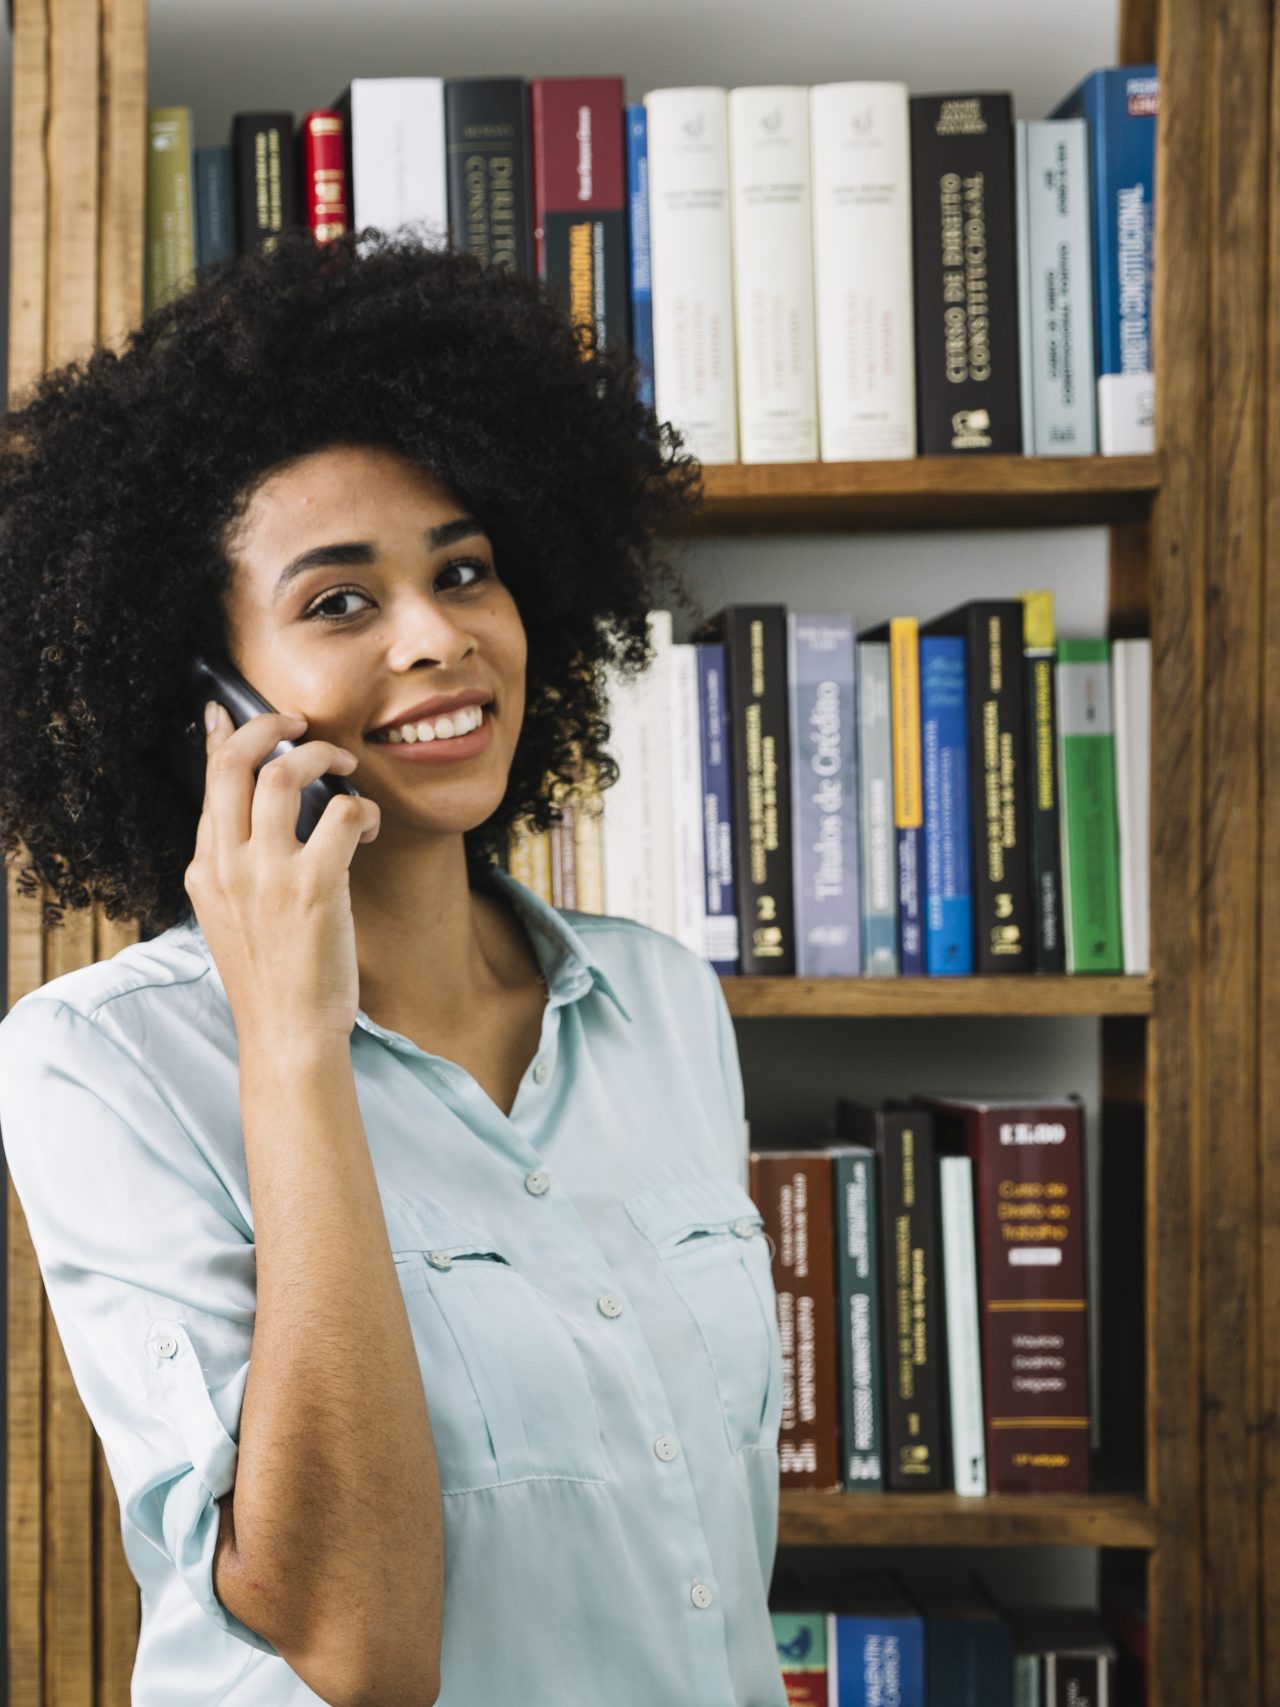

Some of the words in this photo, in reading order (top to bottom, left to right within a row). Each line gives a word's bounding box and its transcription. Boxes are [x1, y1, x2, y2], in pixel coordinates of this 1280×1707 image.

[939, 172, 963, 266] DIREITO
[942, 269, 964, 303] DE
[962, 171, 991, 382] CONSTITUCIONAL
[943, 306, 968, 384] CURSO
[808, 681, 841, 776] Crédito
[811, 779, 841, 813] de
[813, 815, 843, 902] Títulos
[757, 894, 776, 920] 2
[994, 893, 1013, 918] 3
[1044, 1181, 1068, 1199] de
[1046, 1202, 1071, 1220] do
[1001, 1221, 1068, 1242] Trabalho
